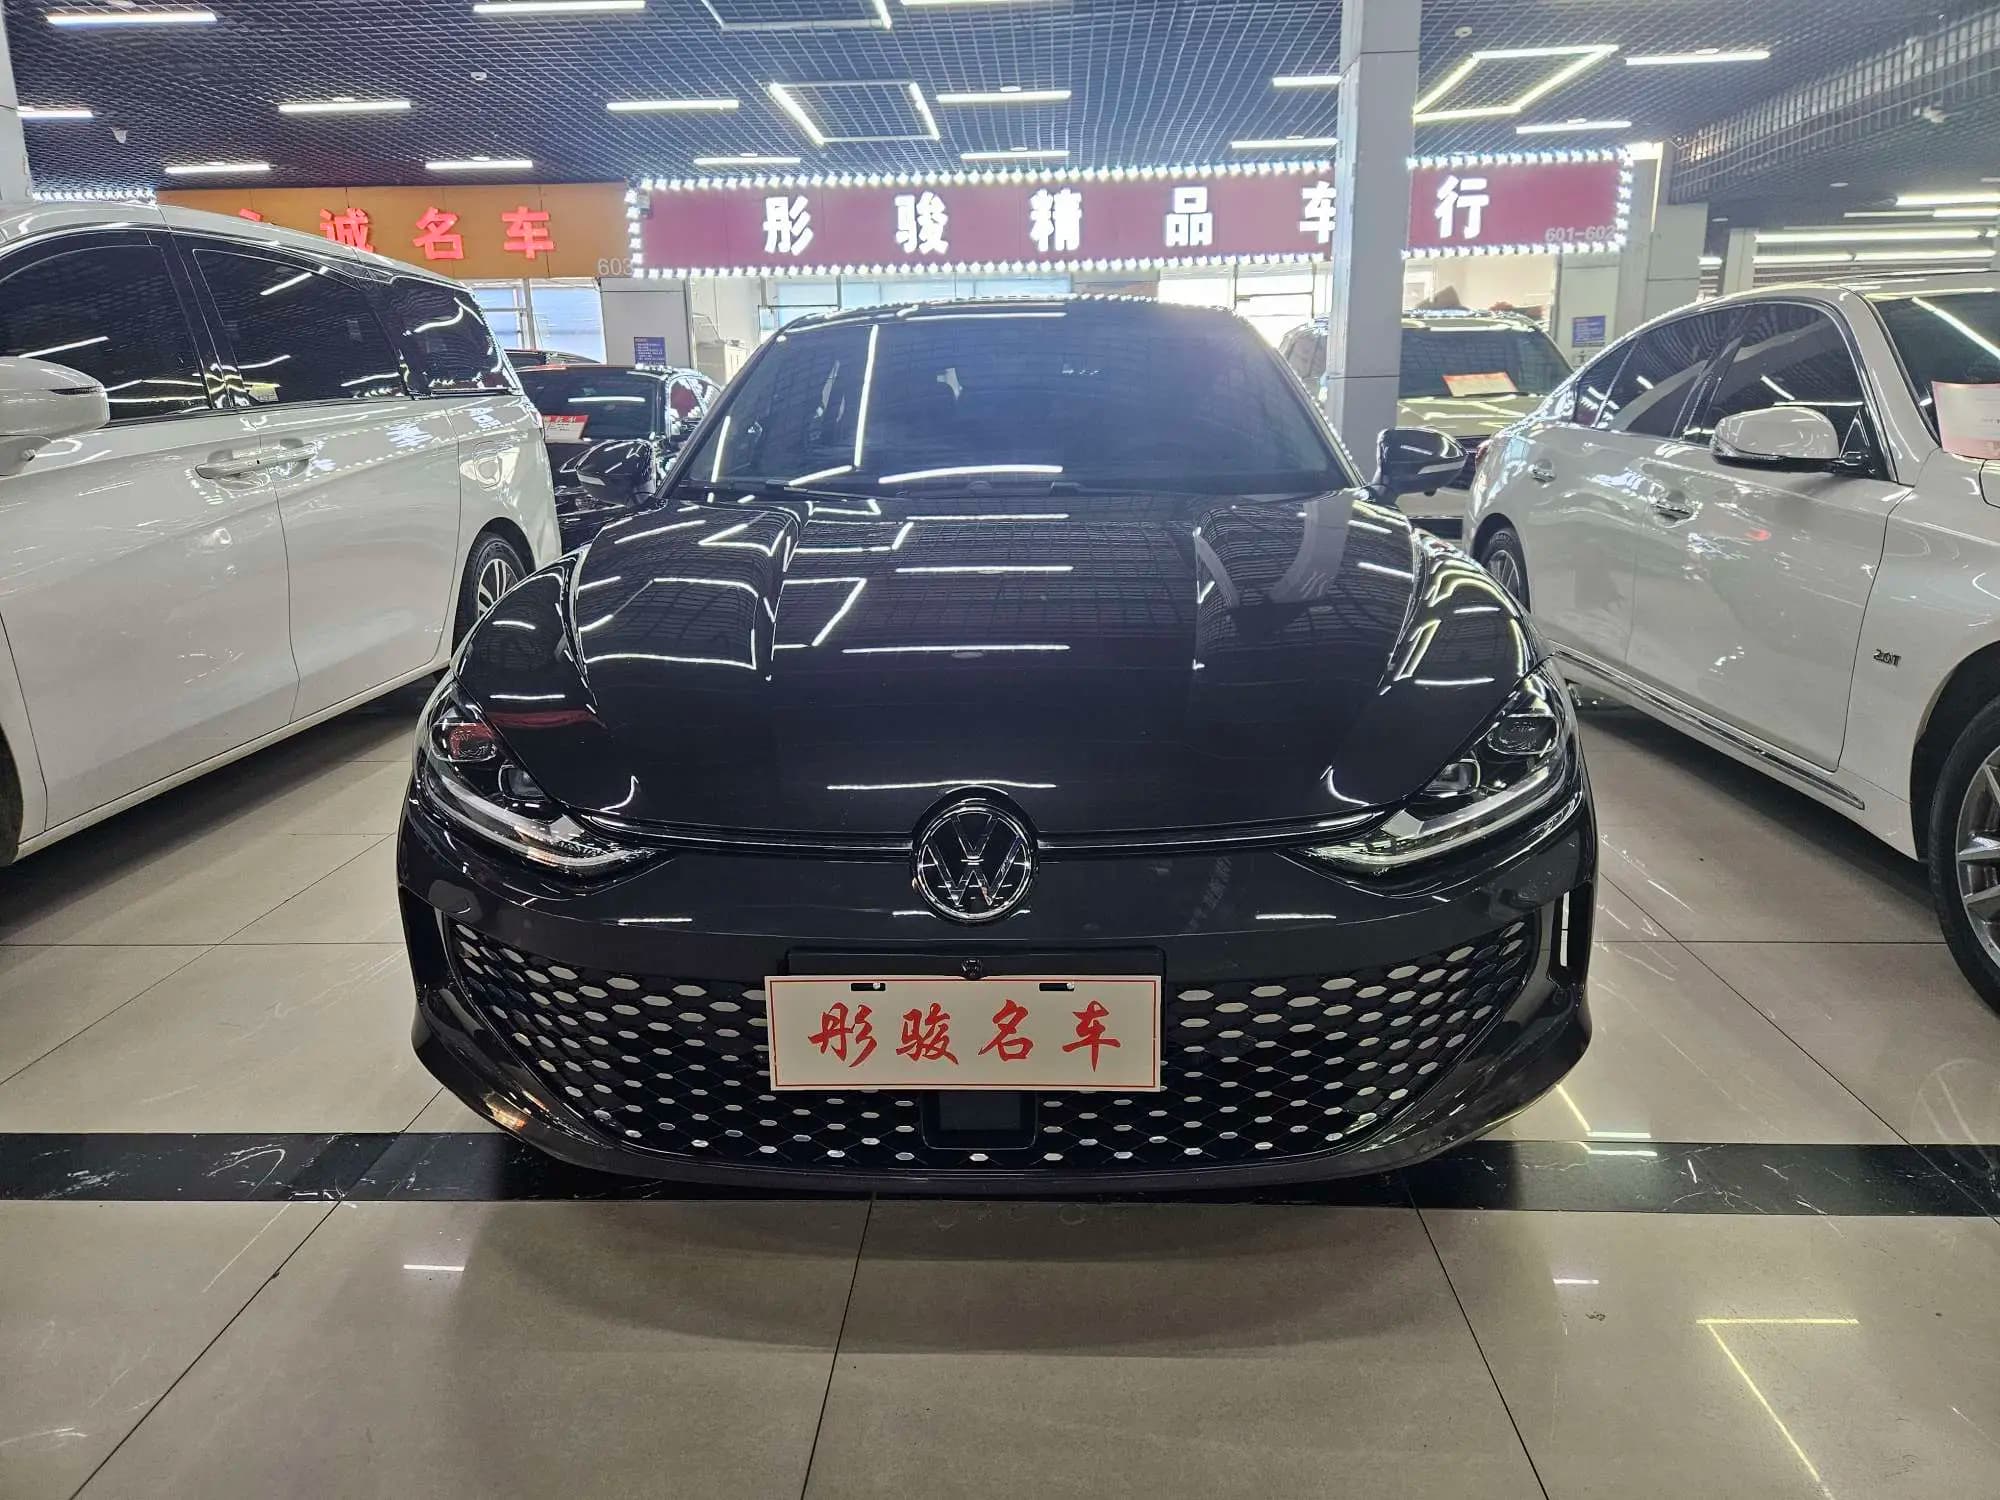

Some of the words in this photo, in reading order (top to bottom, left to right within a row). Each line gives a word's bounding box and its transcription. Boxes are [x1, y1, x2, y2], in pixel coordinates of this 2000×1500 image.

[239, 206, 554, 259] 诚名车
[763, 175, 1490, 256] 彤骏精品车行
[1545, 225, 1616, 241] 601-602
[920, 808, 1030, 910] VW
[807, 999, 1121, 1073] 彤骏名车
